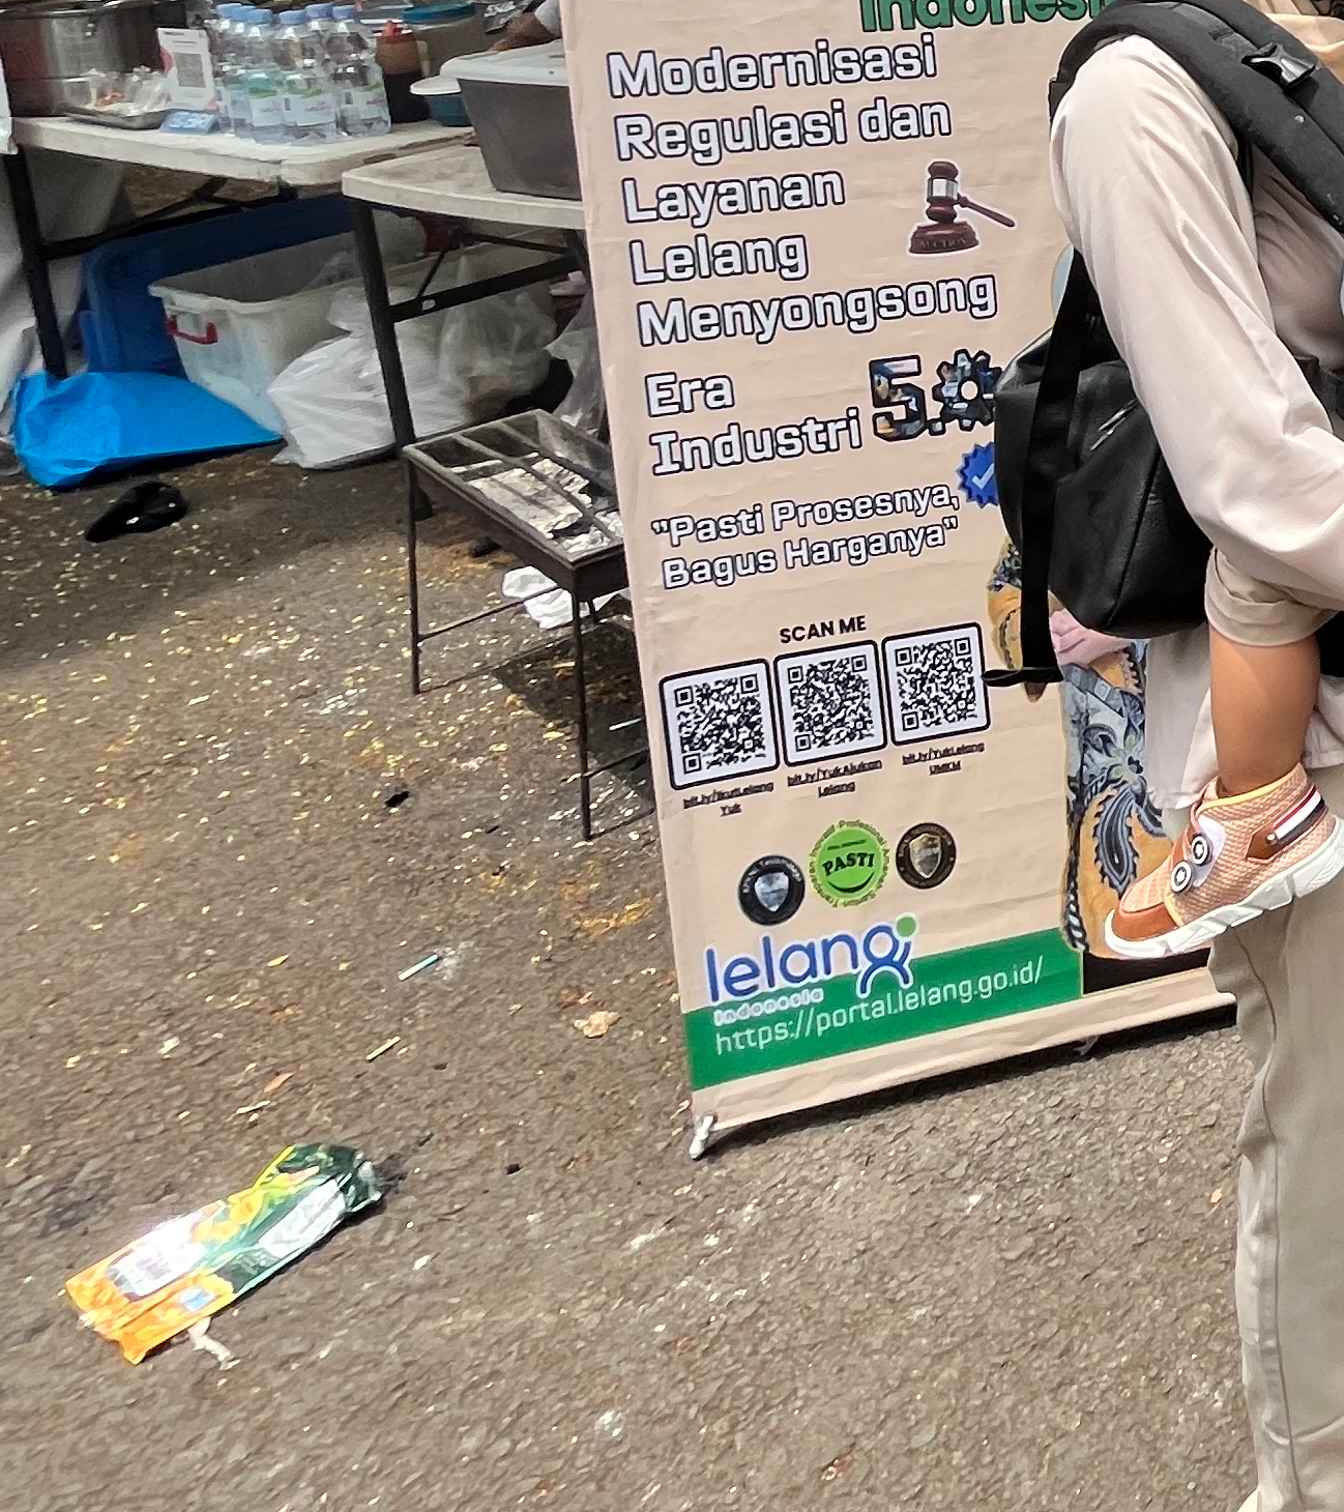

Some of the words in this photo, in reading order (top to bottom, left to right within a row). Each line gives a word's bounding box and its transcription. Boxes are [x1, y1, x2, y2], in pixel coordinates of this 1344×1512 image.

[606, 34, 938, 98] Modernisasi
[614, 99, 849, 165] Regulasi
[857, 96, 953, 143] dan
[620, 169, 846, 227] Layanan
[629, 232, 809, 285] Lelang
[636, 274, 998, 347] Menyongsong
[644, 371, 735, 418] Era
[649, 408, 863, 477] Industri
[772, 483, 960, 531] Prosesnya,
[662, 550, 778, 590] Bagus
[779, 621, 835, 645] SCAN
[839, 615, 867, 636] ME
[821, 851, 876, 877] PASTI
